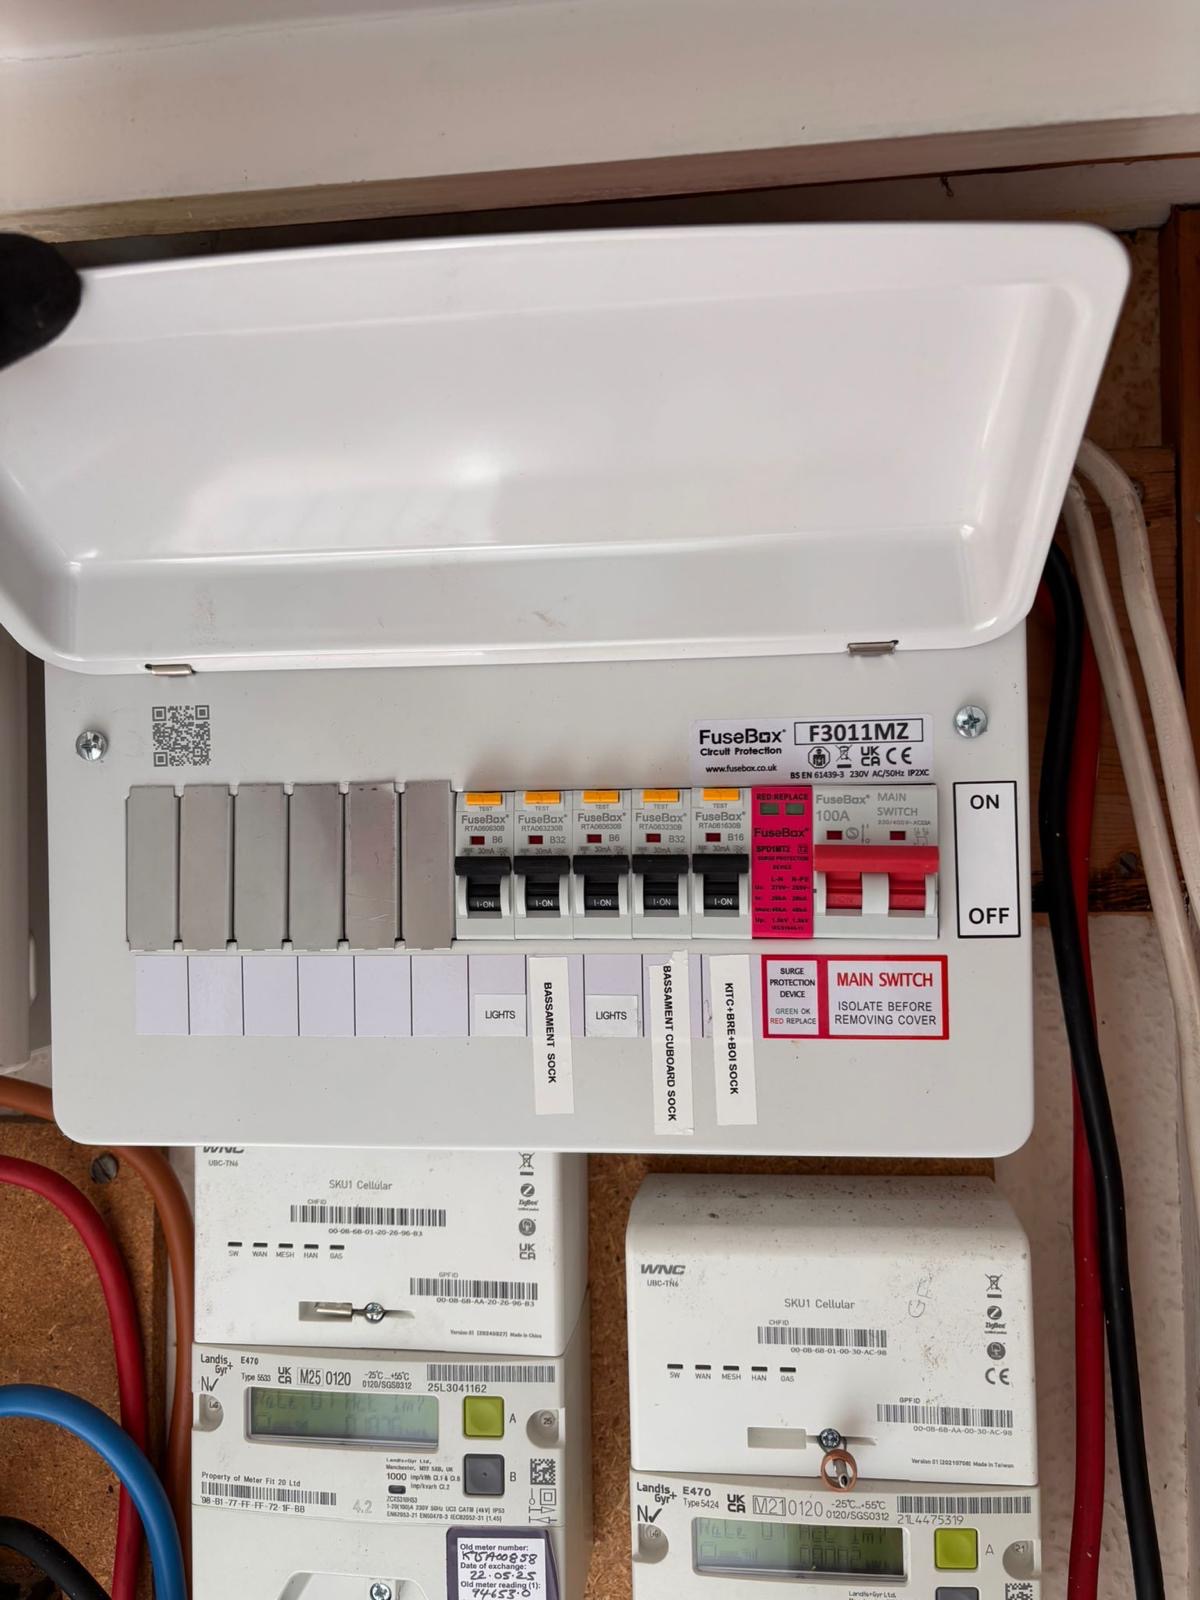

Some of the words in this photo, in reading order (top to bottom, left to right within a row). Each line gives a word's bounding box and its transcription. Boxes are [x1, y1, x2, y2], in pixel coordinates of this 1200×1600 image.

[700, 728, 783, 744] FuseBox
[809, 722, 909, 742] F3011MZ
[700, 747, 731, 756] Circuit
[734, 746, 782, 756] Protection
[706, 764, 777, 774] www.fusebox.co.uk
[790, 772, 800, 780] BS
[908, 768, 930, 776] IP2XC
[816, 794, 866, 804] FuseBox
[878, 792, 906, 802] MAIN
[970, 794, 1000, 810] ON
[578, 813, 622, 822] FuseBox
[636, 812, 683, 822] FuseBox
[696, 812, 742, 821] FuseBox
[816, 810, 850, 822] 100A
[876, 808, 918, 816] SWITCH
[461, 814, 506, 824] FuseBox
[518, 814, 564, 824] FuseBox
[968, 908, 1010, 924] OFF
[837, 972, 873, 986] MAIN
[879, 972, 933, 987] SWITCH
[663, 965, 674, 1031] BASSAMENT
[838, 1001, 883, 1011] ISOLATE
[888, 1001, 932, 1011] BEFORE
[485, 1010, 516, 1020] LIGHTS
[544, 982, 555, 1048] BASSAMENT
[596, 1010, 627, 1020] LIGHTS
[834, 1014, 893, 1025] REMOVING
[898, 1015, 936, 1025] COVER
[724, 982, 737, 1062] KITC+BRE+BOI
[665, 1034, 675, 1087] CUBOARD
[547, 1053, 557, 1084] SOCK
[729, 1064, 739, 1095] SOCK
[667, 1090, 677, 1122] SOCK
[329, 1180, 352, 1189] SKU1
[356, 1180, 392, 1190] Cellular
[640, 1264, 685, 1275] WNC
[784, 1298, 810, 1308] SKU1
[816, 1299, 855, 1309] Cellular
[200, 1354, 229, 1364] Landis
[241, 1372, 255, 1381] Type
[300, 1369, 321, 1384] M25
[326, 1370, 351, 1386] 0120
[362, 1380, 412, 1389] 0120/SGS0312
[428, 1383, 487, 1392] 25L3041162
[509, 1414, 516, 1423] A
[201, 1472, 231, 1482] Property
[244, 1476, 262, 1484] Meter
[510, 1472, 517, 1481] B
[637, 1482, 670, 1494] Landis
[683, 1486, 711, 1496] E470
[352, 1499, 372, 1514] 4.2
[684, 1498, 700, 1507] Type
[701, 1500, 719, 1509] 5424
[754, 1498, 785, 1514] M21
[788, 1500, 823, 1517] 0120
[826, 1510, 889, 1521] 0120/SGS0312
[897, 1514, 964, 1525] 21L4475319
[985, 1544, 994, 1555] A
